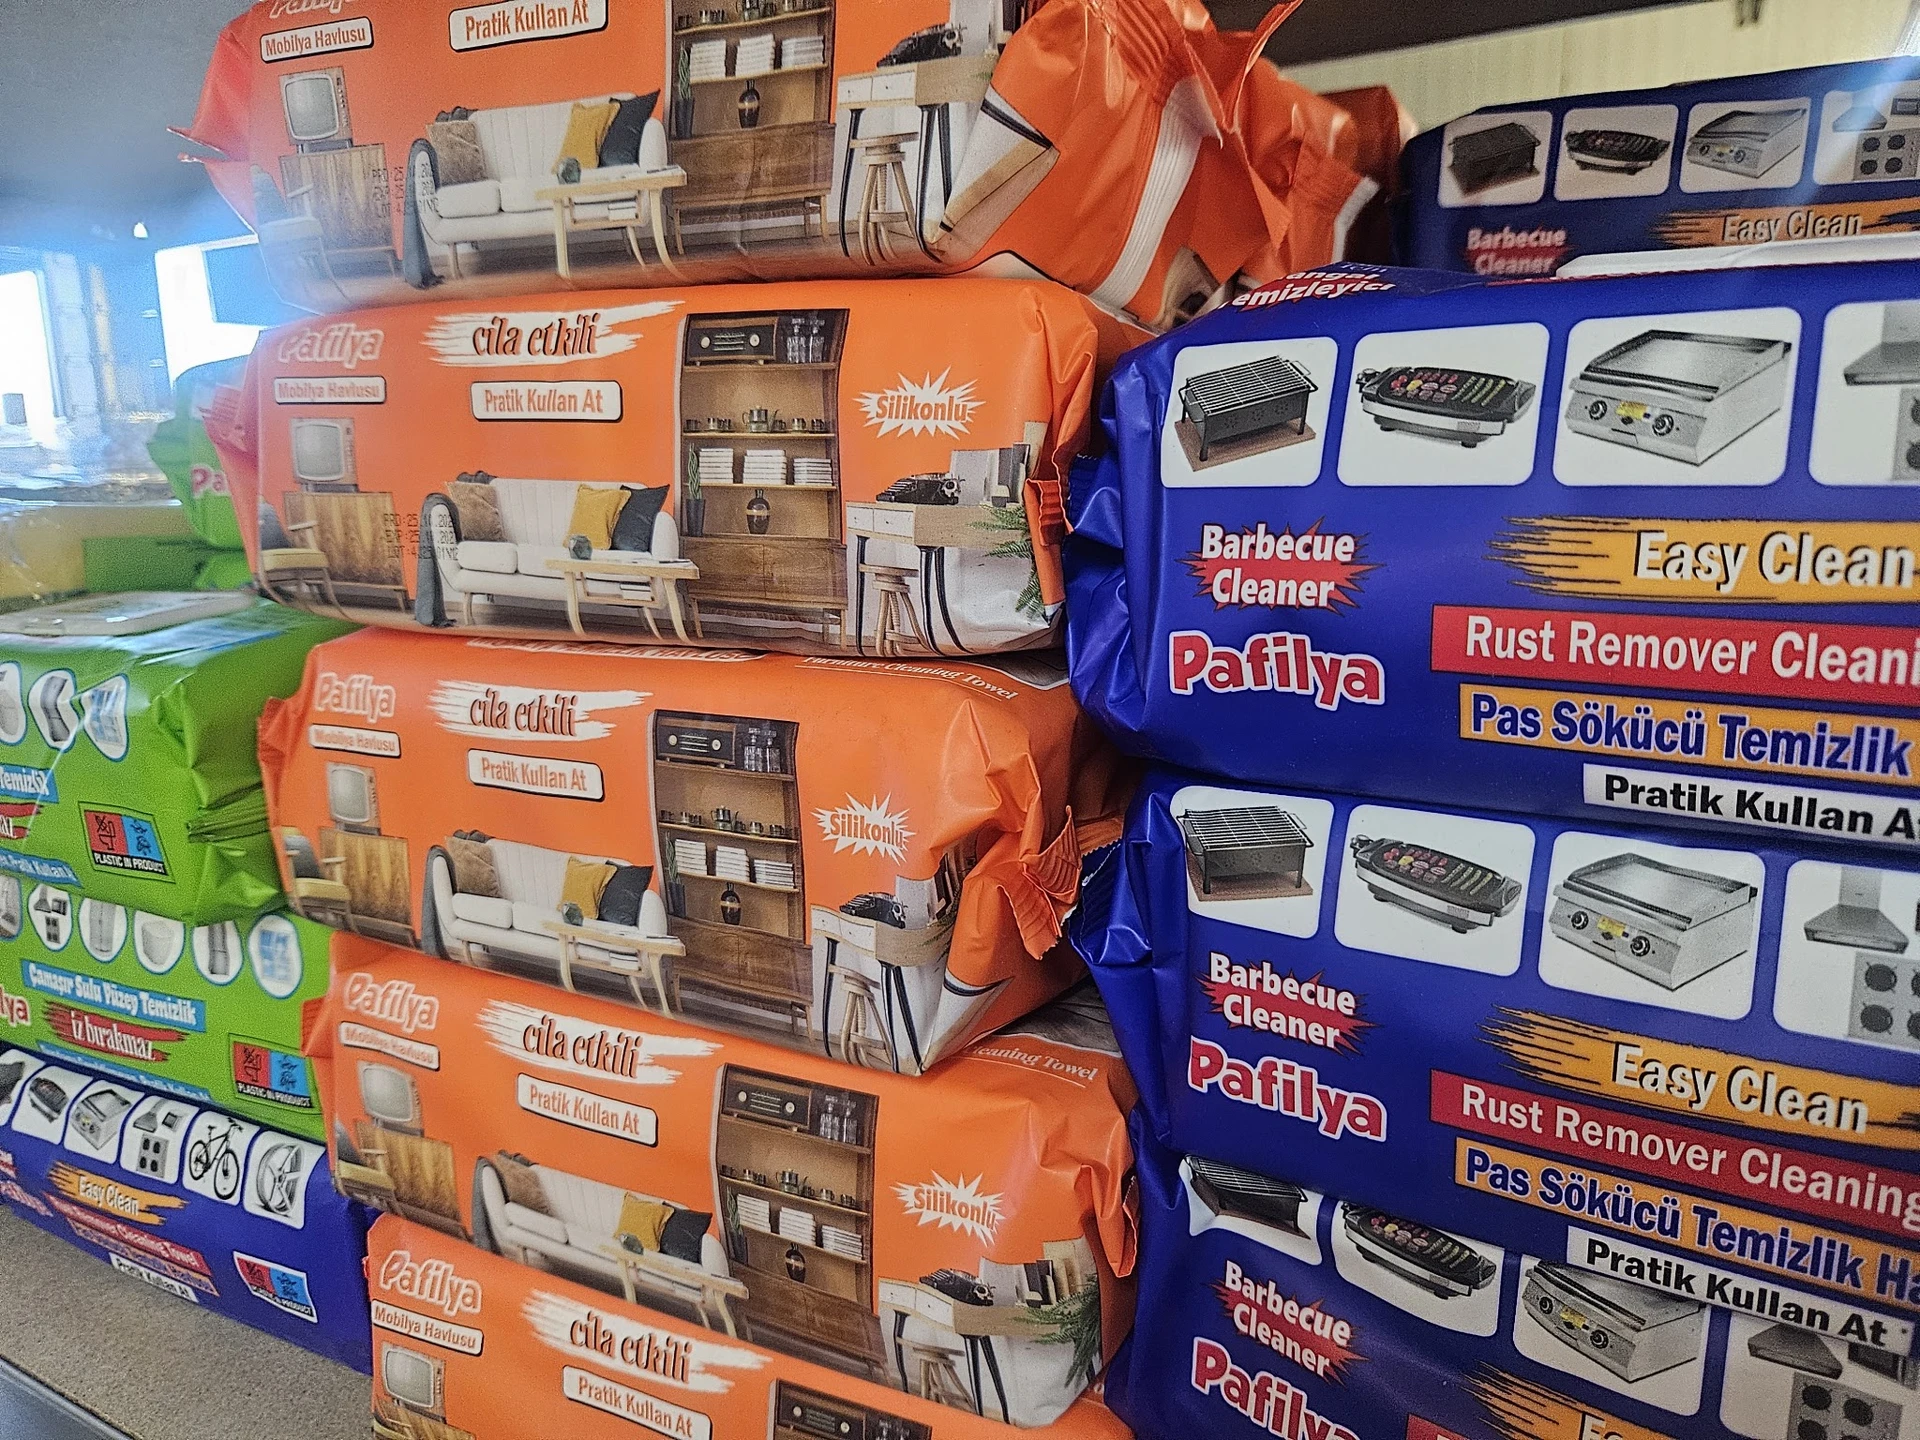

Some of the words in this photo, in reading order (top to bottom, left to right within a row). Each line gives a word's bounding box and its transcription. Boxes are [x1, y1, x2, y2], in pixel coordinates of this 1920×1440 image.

[265, 33, 312, 57] Mobilya
[314, 25, 367, 48] Havlusu
[465, 13, 511, 42] Pratik
[515, 6, 568, 33] Kullan
[571, 1, 590, 25] At
[1467, 226, 1567, 250] Barbecue
[1722, 213, 1781, 244] Easy
[1785, 210, 1864, 240] Clean
[1475, 252, 1555, 275] Cleaner
[472, 316, 523, 356] cila
[527, 312, 602, 357] etkili
[278, 382, 325, 399] Mobilya
[484, 389, 523, 413] Pratik
[527, 388, 578, 413] Kullan
[582, 388, 604, 414] At
[876, 395, 969, 424] Silikonlu
[1202, 523, 1356, 561] Barbecue
[1634, 530, 1748, 595] Easy
[1758, 530, 1914, 589] Clean
[1212, 568, 1335, 607] Cleaner
[1169, 630, 1386, 711] Pafilya
[1466, 615, 1556, 662] Rust
[1568, 620, 1757, 676] Remover
[314, 672, 396, 724] Pafilya
[884, 661, 963, 679] Cleaning
[961, 672, 1019, 700] Towel
[469, 687, 509, 728] cila
[514, 692, 578, 738] etkili
[1471, 692, 1541, 739] Pas
[1551, 699, 1706, 757] Sökücü
[1718, 713, 1912, 778] Temizlik
[480, 756, 520, 784] Pratik
[520, 761, 568, 790] Kullan
[570, 767, 588, 792] At
[829, 812, 905, 849] Silikonlu
[1604, 773, 1724, 816] Pratik
[1735, 788, 1875, 835] Kullan
[1884, 806, 1920, 840] A
[93, 852, 124, 867] PLASTIC
[344, 972, 440, 1034] Pafilya
[1209, 951, 1356, 1015] Barbecue
[523, 1014, 569, 1060] cila
[572, 1029, 643, 1079] etkili
[1222, 994, 1340, 1048] Cleaner
[1042, 1055, 1099, 1081] Towel
[1187, 1035, 1387, 1142] Pafilya
[1610, 1041, 1717, 1109] Easy
[1726, 1065, 1868, 1134] Clean
[529, 1084, 570, 1118] Pratik
[572, 1095, 620, 1131] Kullan
[622, 1110, 640, 1137] At
[1462, 1083, 1544, 1134] Rust
[1554, 1105, 1727, 1175] Remover
[78, 1174, 105, 1208] Easy
[104, 1183, 139, 1216] Clean
[913, 1186, 998, 1232] Silikonlu
[1465, 1147, 1530, 1196] Pas
[1537, 1167, 1681, 1240] Sökücü
[1691, 1205, 1864, 1290] Temizlik
[379, 1250, 482, 1317] Pafilya
[1224, 1260, 1352, 1347] Barbecue
[1586, 1238, 1696, 1295] Pratik
[1705, 1273, 1830, 1332] Kullan
[1838, 1314, 1887, 1347] At
[374, 1305, 421, 1335] Mobilya
[423, 1320, 476, 1349] Havlusu
[570, 1310, 616, 1359] cila
[620, 1325, 692, 1384] etkili
[1232, 1302, 1331, 1377] Cleaner
[578, 1376, 623, 1408] Pratik
[625, 1391, 673, 1432] Kullan
[675, 1409, 693, 1438] At
[1191, 1336, 1361, 1440] Pafily
